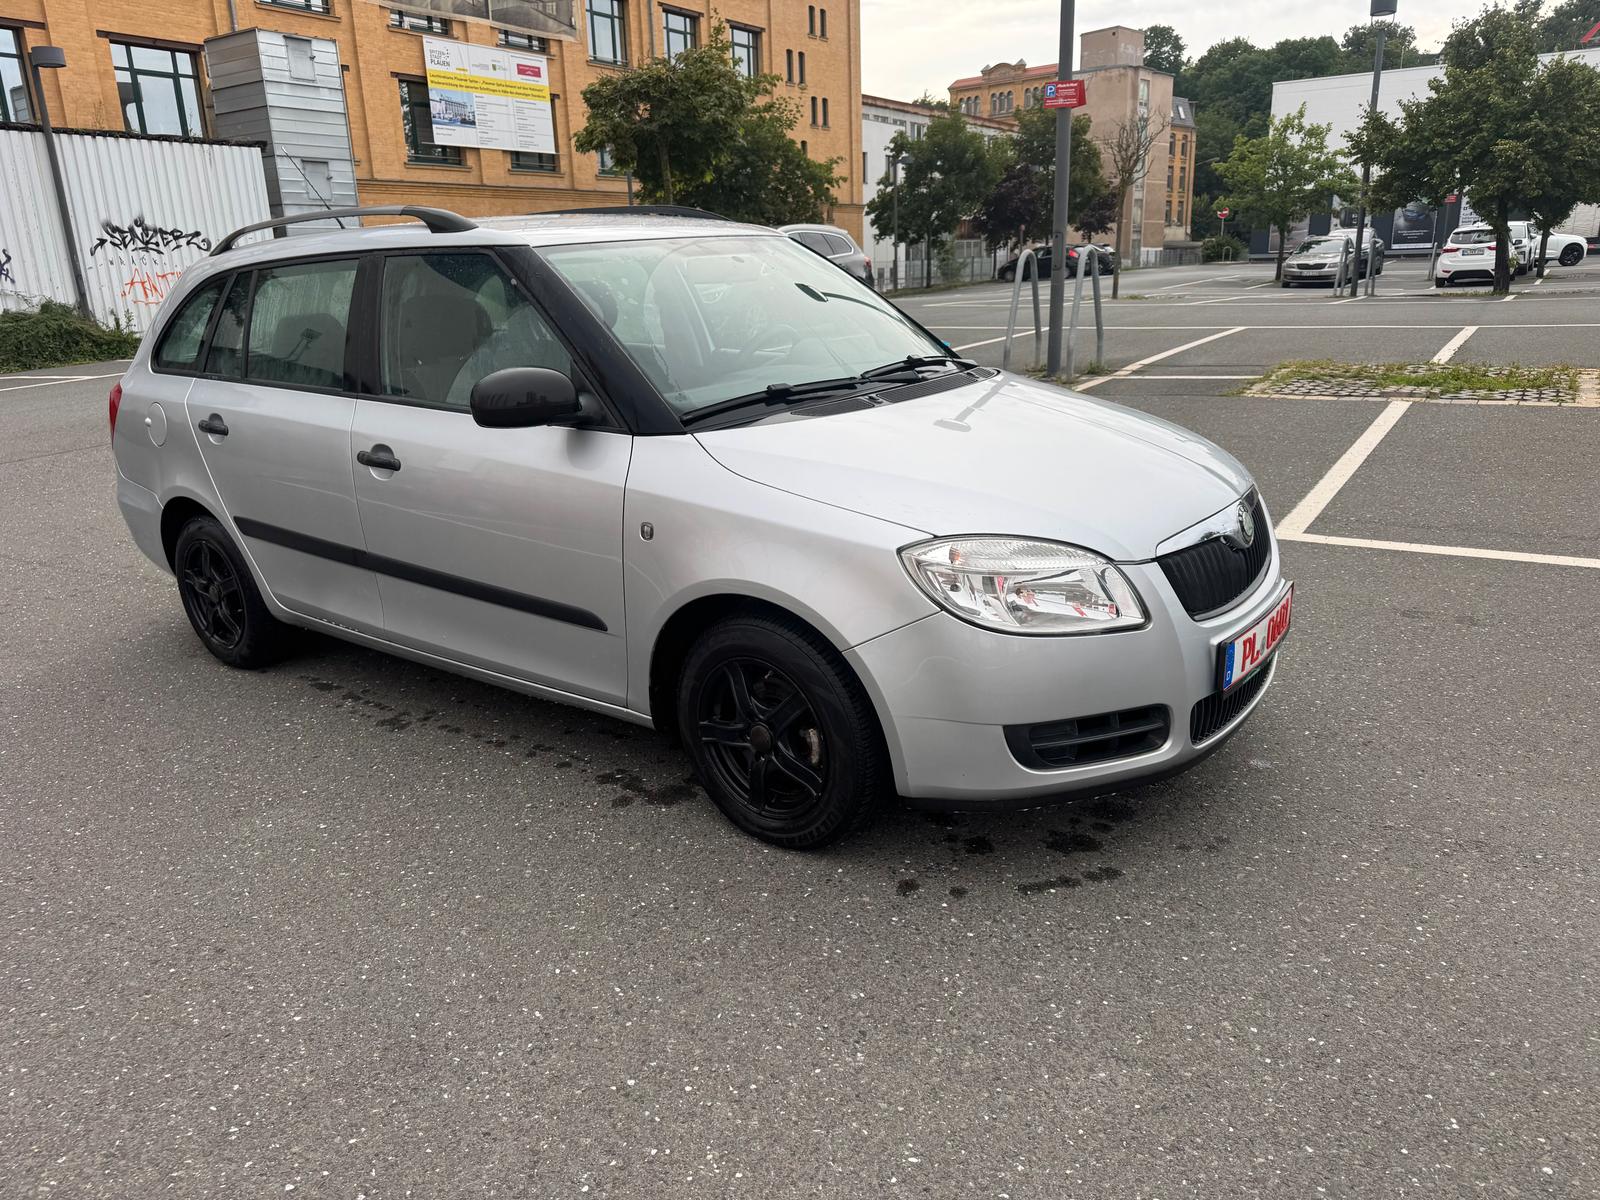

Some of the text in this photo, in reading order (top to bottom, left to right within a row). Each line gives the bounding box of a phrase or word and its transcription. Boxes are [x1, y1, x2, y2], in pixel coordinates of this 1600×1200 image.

[430, 58, 450, 67] PLAUEN
[1048, 86, 1054, 96] P
[1241, 633, 1260, 672] PL
